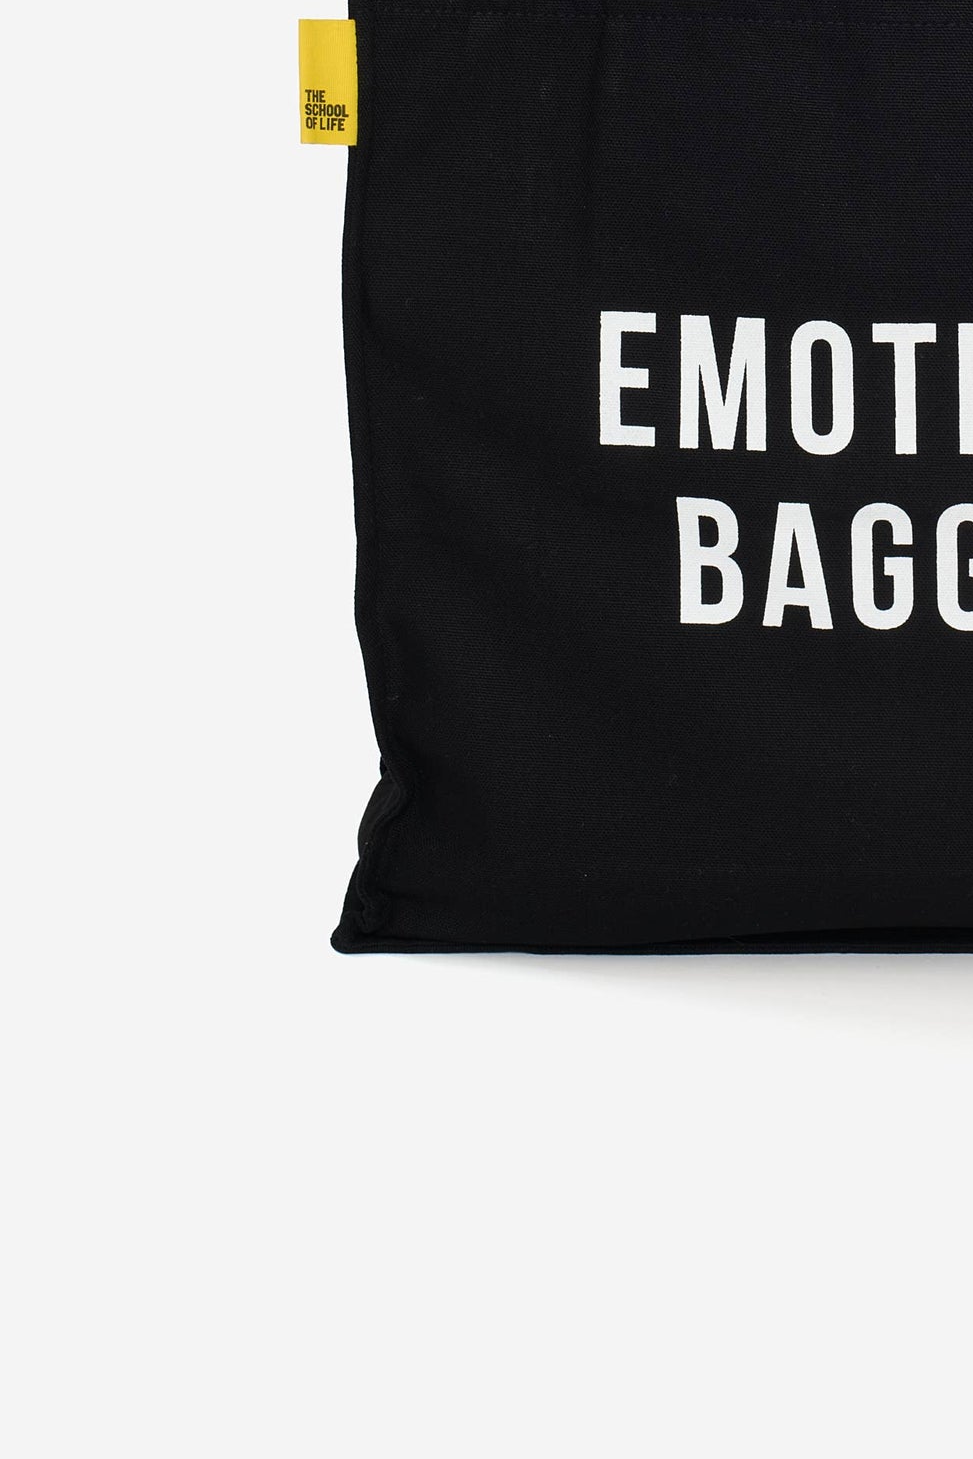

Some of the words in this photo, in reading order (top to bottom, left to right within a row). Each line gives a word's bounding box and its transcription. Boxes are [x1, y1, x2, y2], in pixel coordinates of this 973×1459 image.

[305, 89, 326, 103] THE
[305, 103, 349, 118] SCHOOL
[306, 117, 318, 130] OF
[320, 118, 345, 131] LIFE
